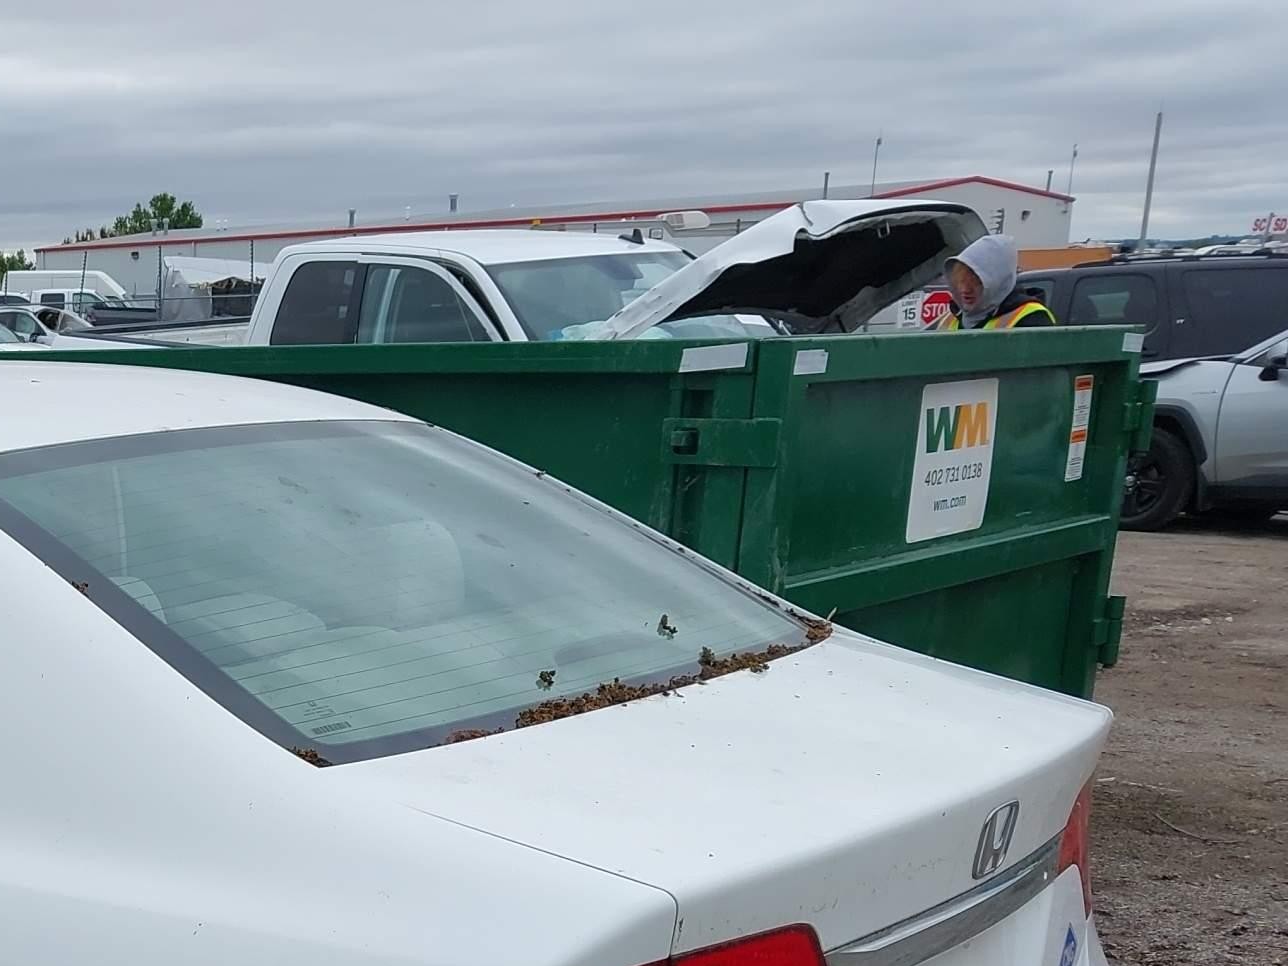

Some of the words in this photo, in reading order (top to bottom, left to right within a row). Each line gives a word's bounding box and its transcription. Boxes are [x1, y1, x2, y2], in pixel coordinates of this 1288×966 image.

[902, 308, 916, 320] 15
[923, 303, 951, 318] STO
[926, 402, 989, 454] WM
[924, 468, 943, 487] 402
[944, 466, 961, 486] 731
[962, 462, 983, 481] 0138
[933, 496, 967, 512] wm.com
